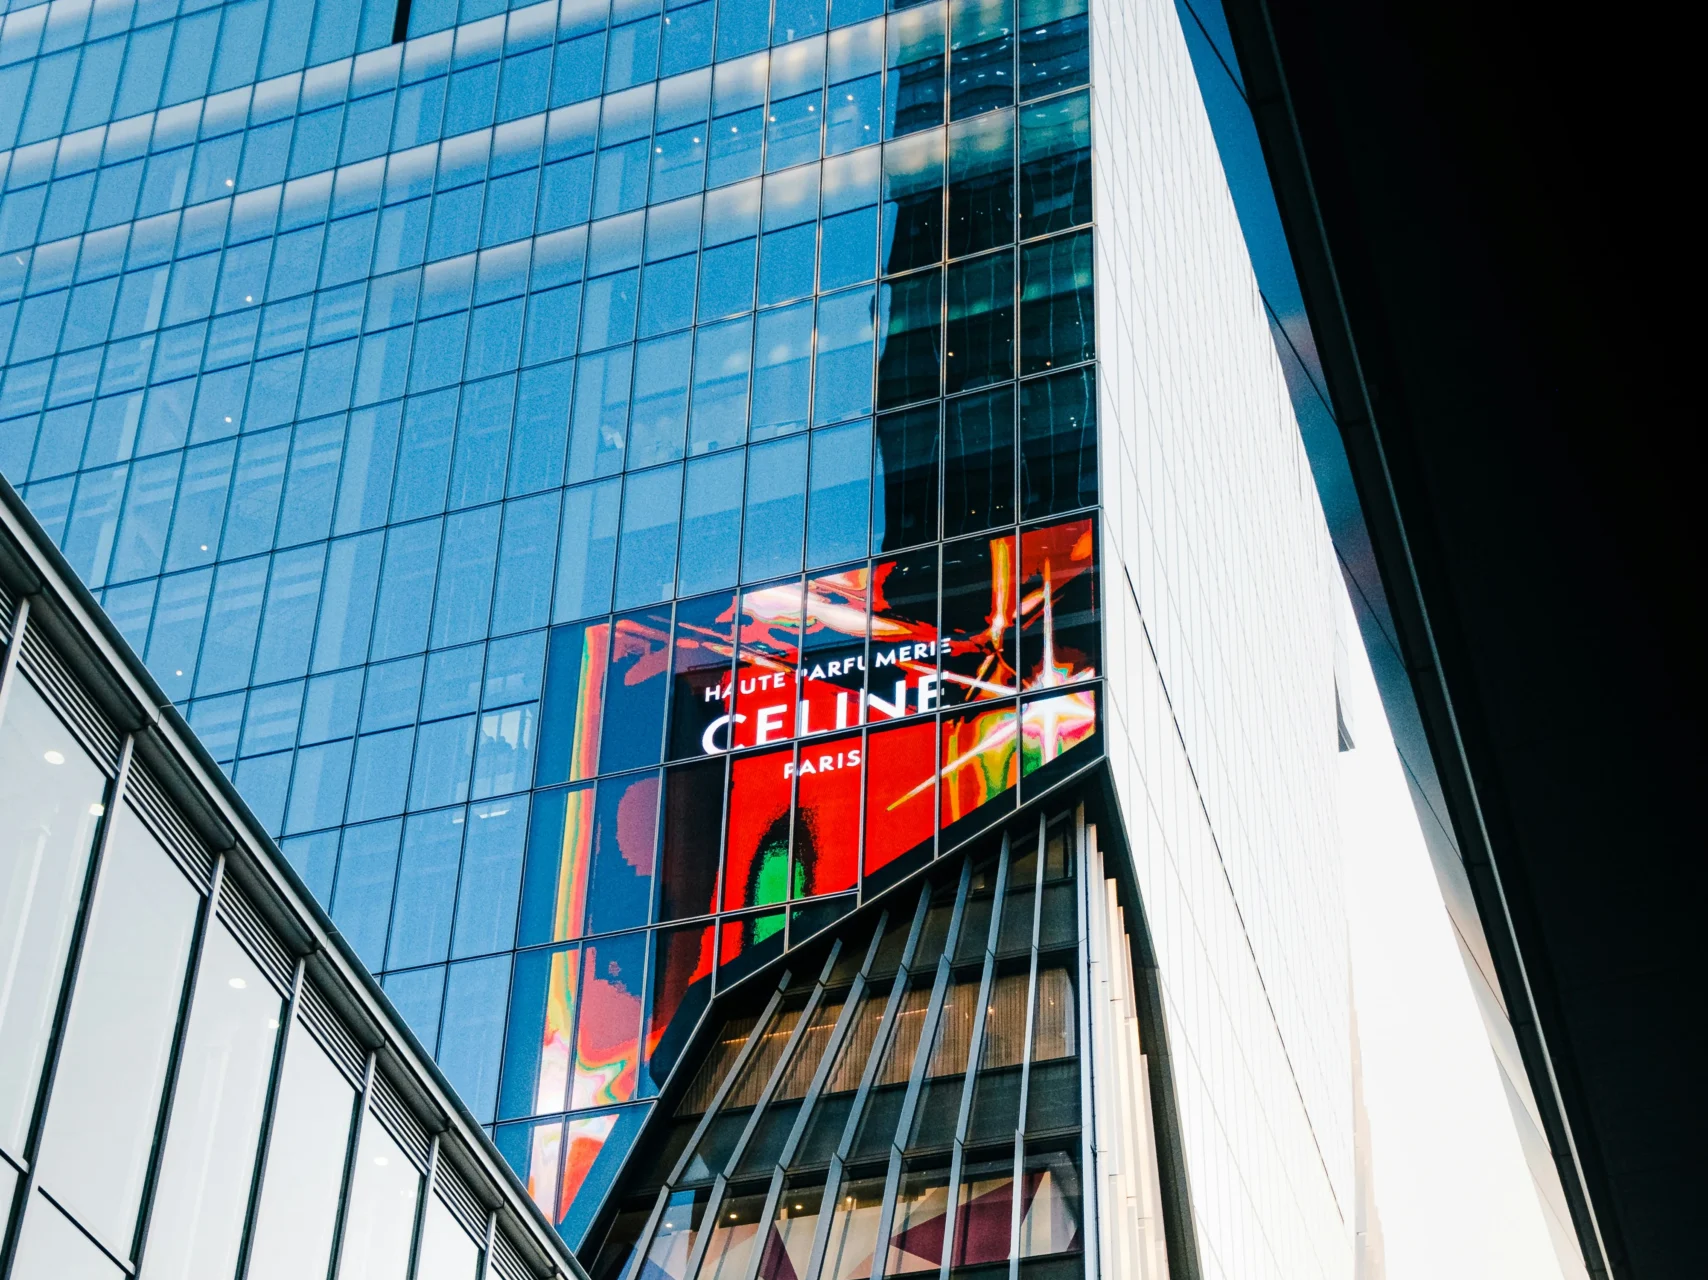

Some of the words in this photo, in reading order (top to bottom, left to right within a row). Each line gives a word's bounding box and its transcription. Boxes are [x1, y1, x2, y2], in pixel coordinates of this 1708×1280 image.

[705, 671, 785, 702] HAUTE
[795, 638, 951, 684] PARFUMERIE
[702, 671, 951, 755] CELINE
[784, 750, 860, 779] PARIS
